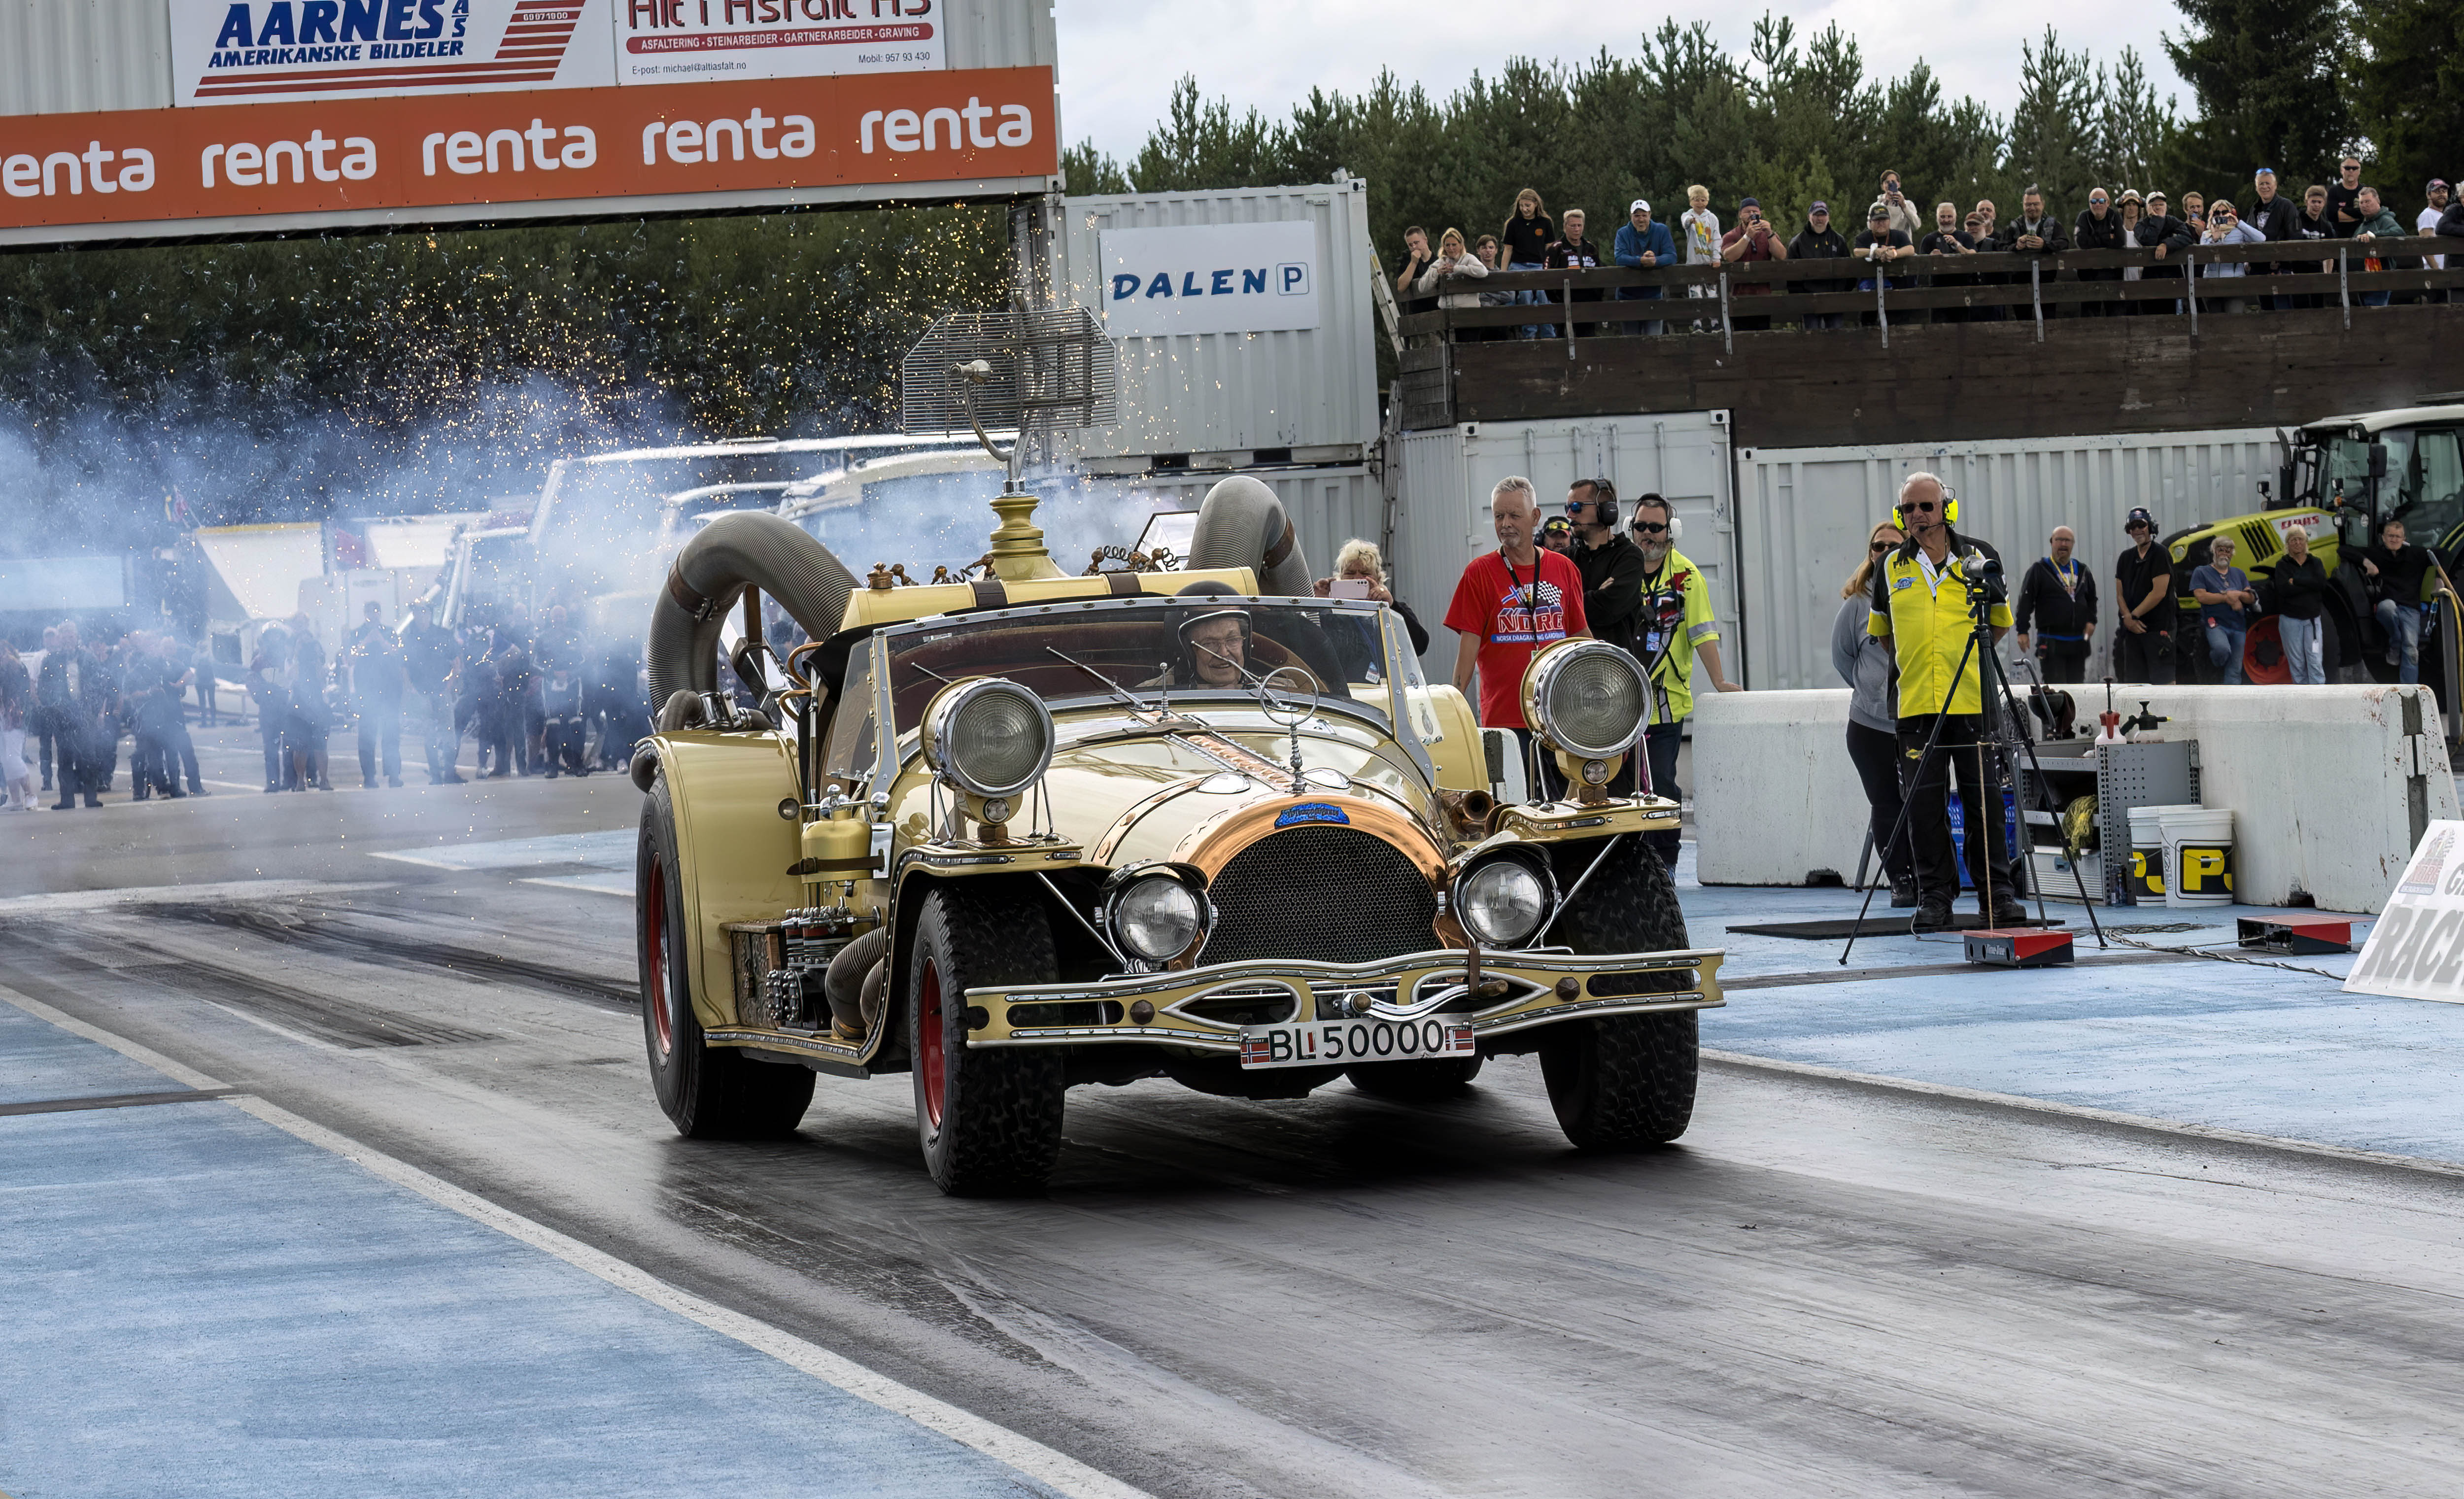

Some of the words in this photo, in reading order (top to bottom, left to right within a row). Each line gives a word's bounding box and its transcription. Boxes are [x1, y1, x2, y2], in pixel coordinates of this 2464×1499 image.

[215, 0, 444, 48] AARNES
[641, 37, 699, 50] ASFALTERING
[707, 33, 778, 47] STEINARBEIDER
[784, 29, 873, 43] GARTNERARBEIDER
[879, 27, 920, 38] GRAVING
[208, 44, 362, 68] AMERIKANSKE
[369, 40, 464, 60] BILDELER
[885, 53, 900, 62] 957
[915, 51, 930, 61] 430
[422, 118, 597, 176] renta
[642, 107, 816, 166] renta
[860, 97, 1032, 154] renta
[0, 140, 155, 198] enta
[201, 129, 376, 188] renta
[1112, 268, 1266, 300] DALEN
[2184, 849, 2233, 891] P
[2445, 861, 2464, 895] G
